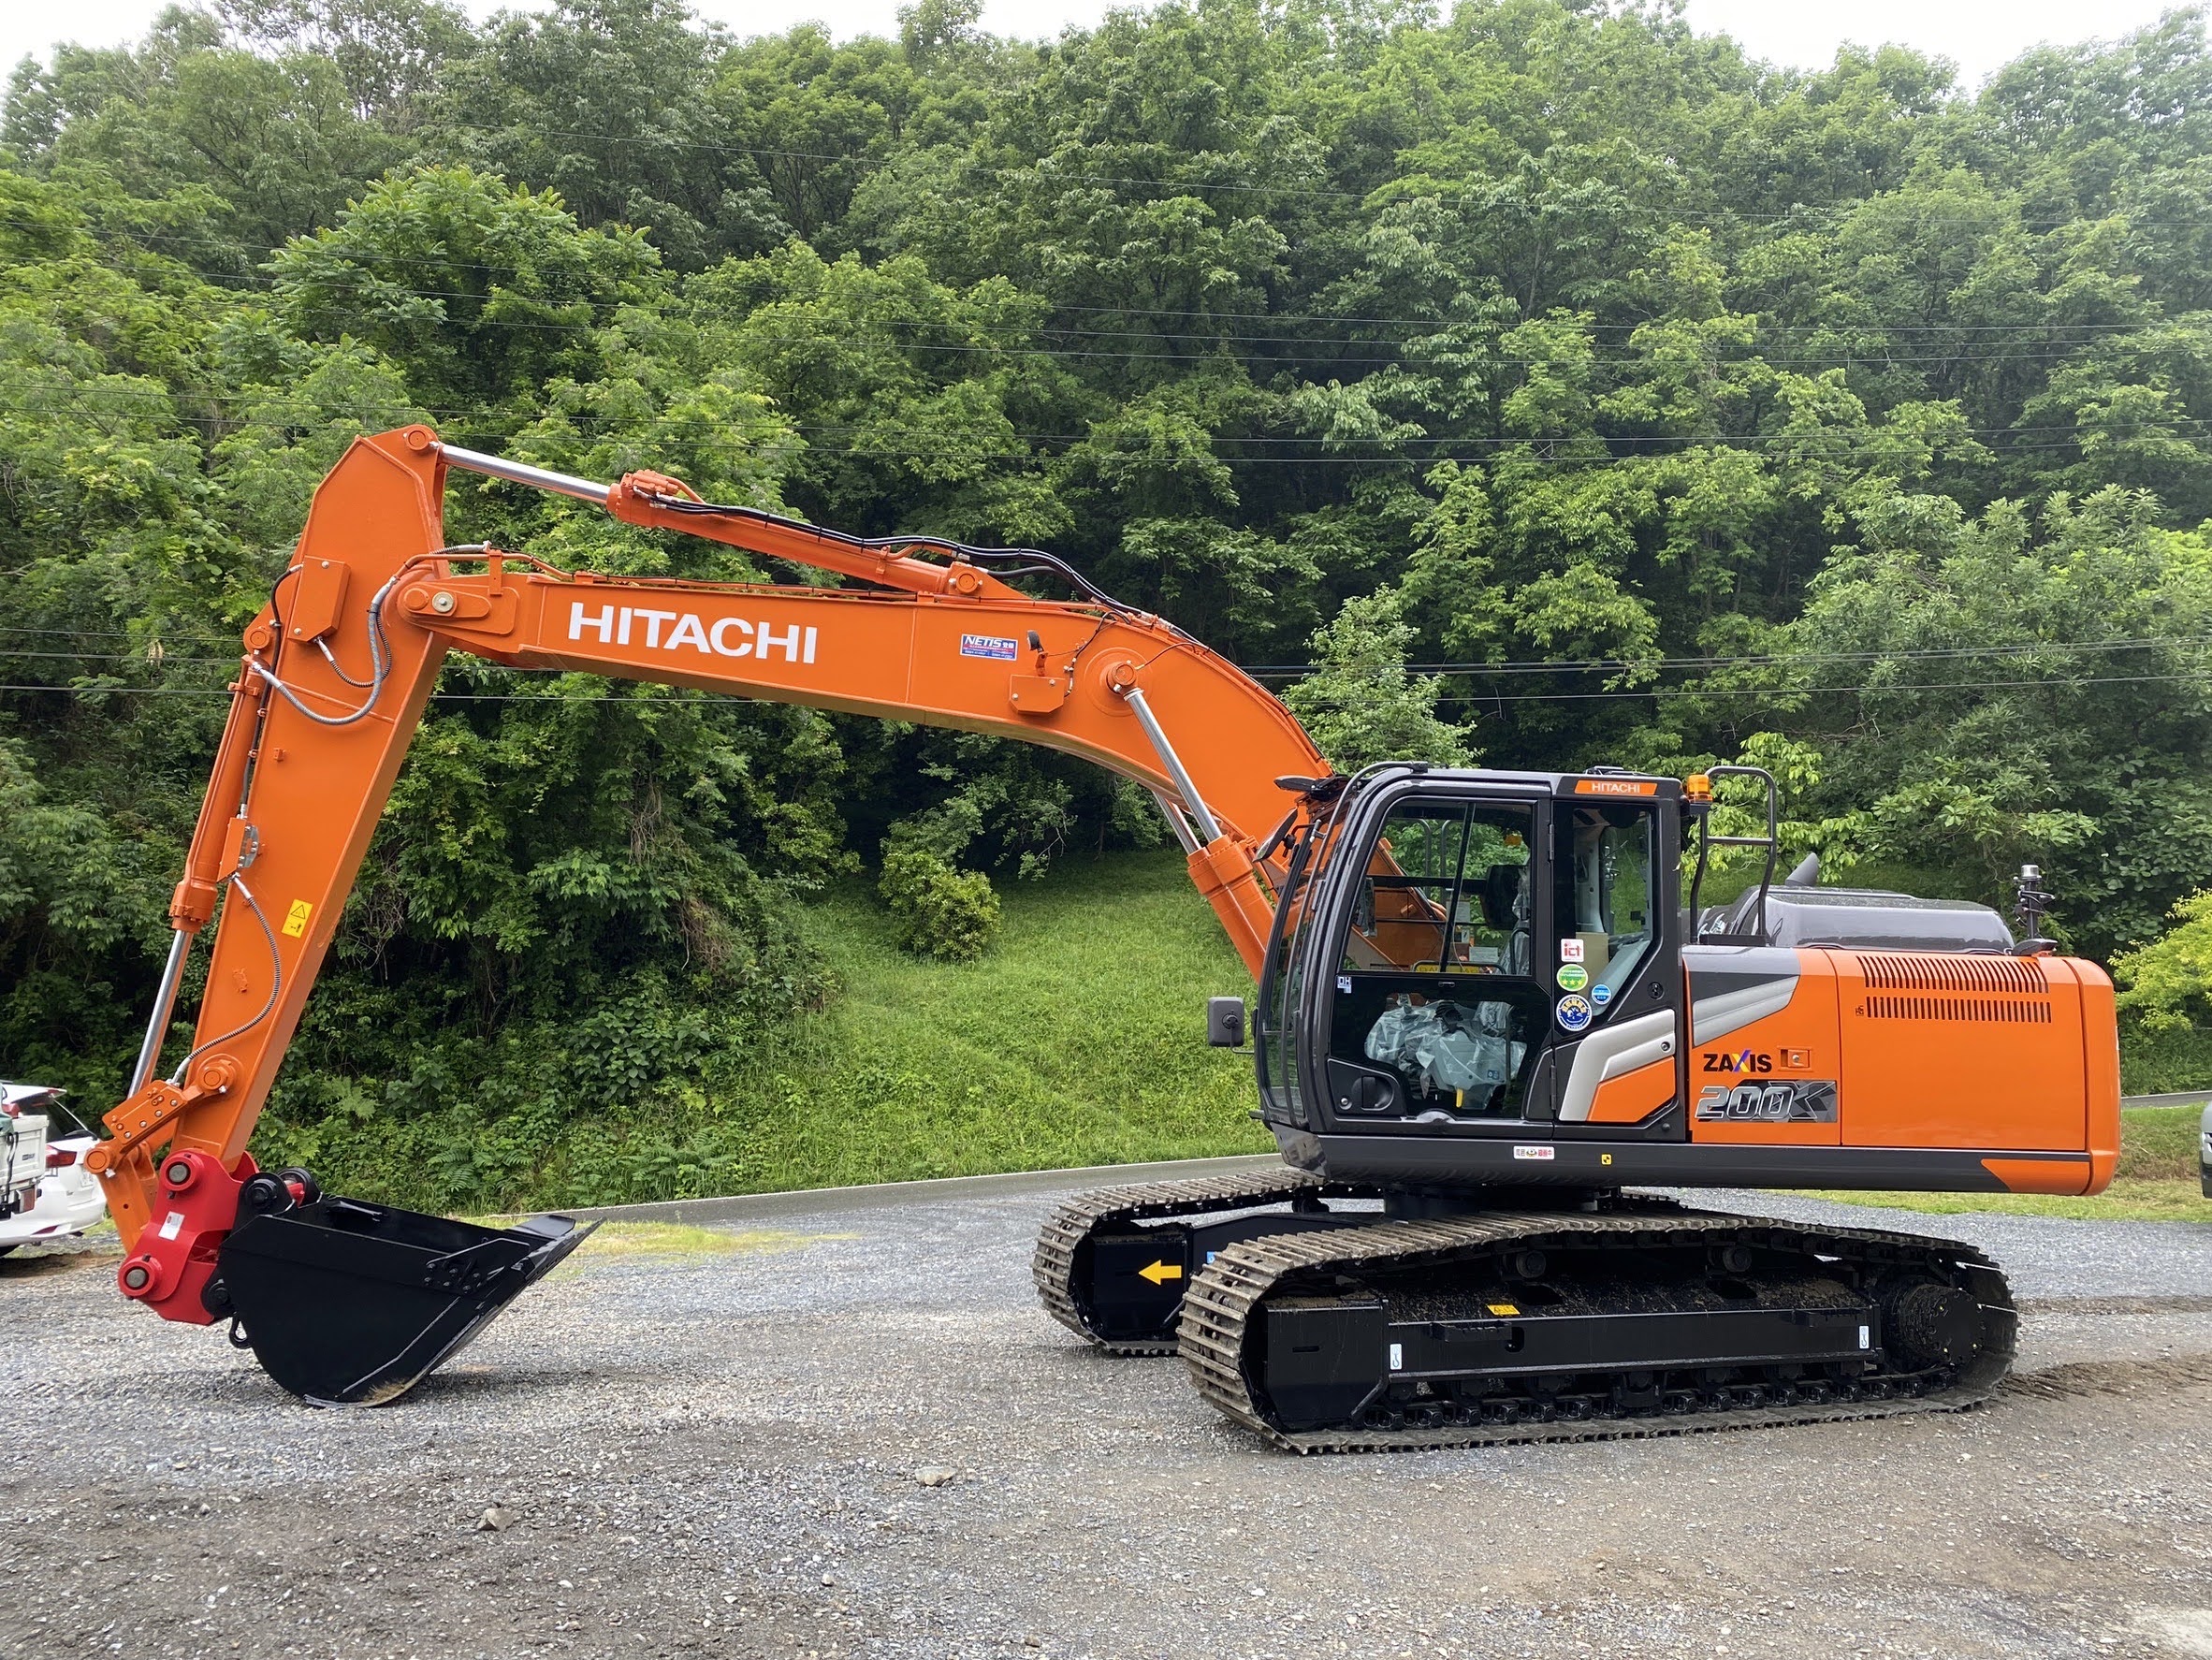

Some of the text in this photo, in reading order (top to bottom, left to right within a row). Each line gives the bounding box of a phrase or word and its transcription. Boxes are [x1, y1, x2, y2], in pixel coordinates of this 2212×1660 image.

[568, 601, 818, 664] HITACHI
[965, 636, 1002, 648] NETIS
[1592, 782, 1640, 794] HITACHI
[1703, 1049, 1773, 1073] ZAXIS
